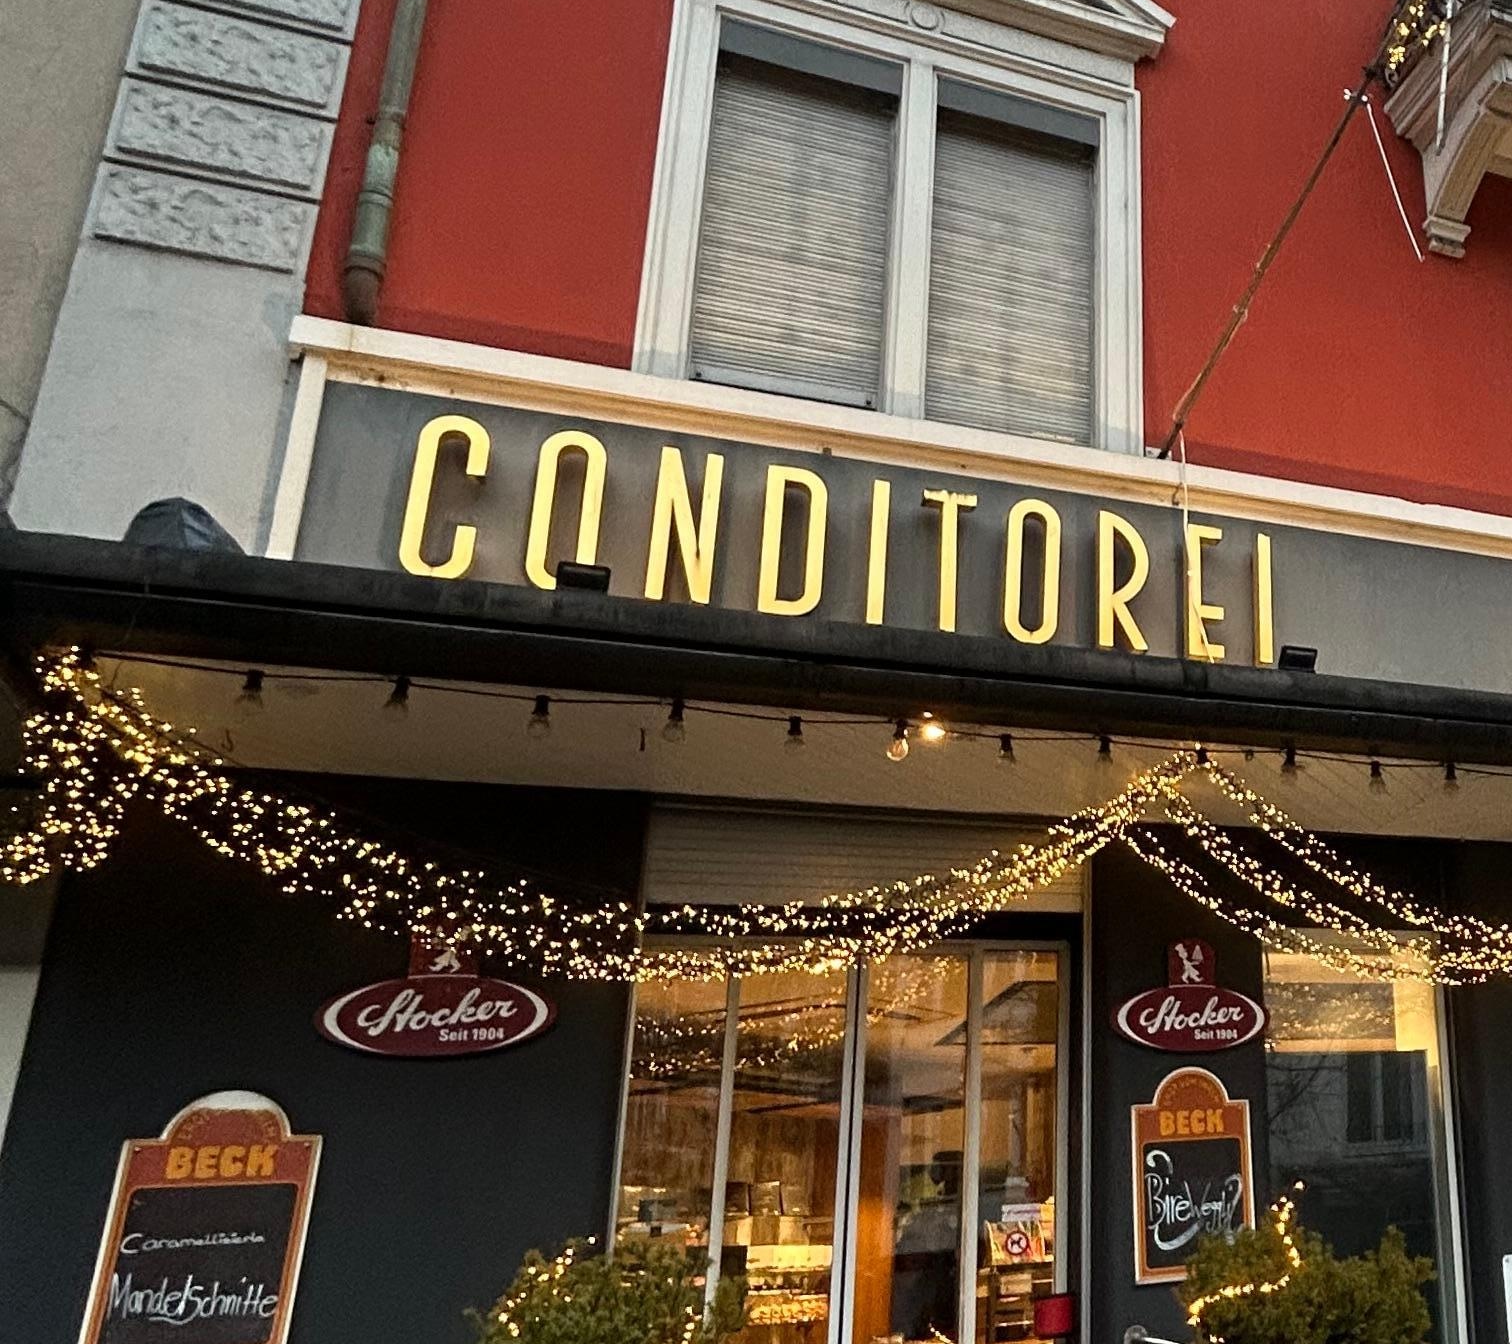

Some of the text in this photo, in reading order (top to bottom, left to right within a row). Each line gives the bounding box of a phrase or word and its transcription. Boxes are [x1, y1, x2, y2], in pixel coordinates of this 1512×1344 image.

[399, 414, 1274, 665] CONDITOREI
[356, 987, 518, 1036] Stocker
[1139, 995, 1244, 1034] Stocker
[438, 1028, 468, 1042] Seit
[1194, 1029, 1213, 1040] Seit
[1159, 1109, 1224, 1136] BECK
[165, 1144, 278, 1180] BECK
